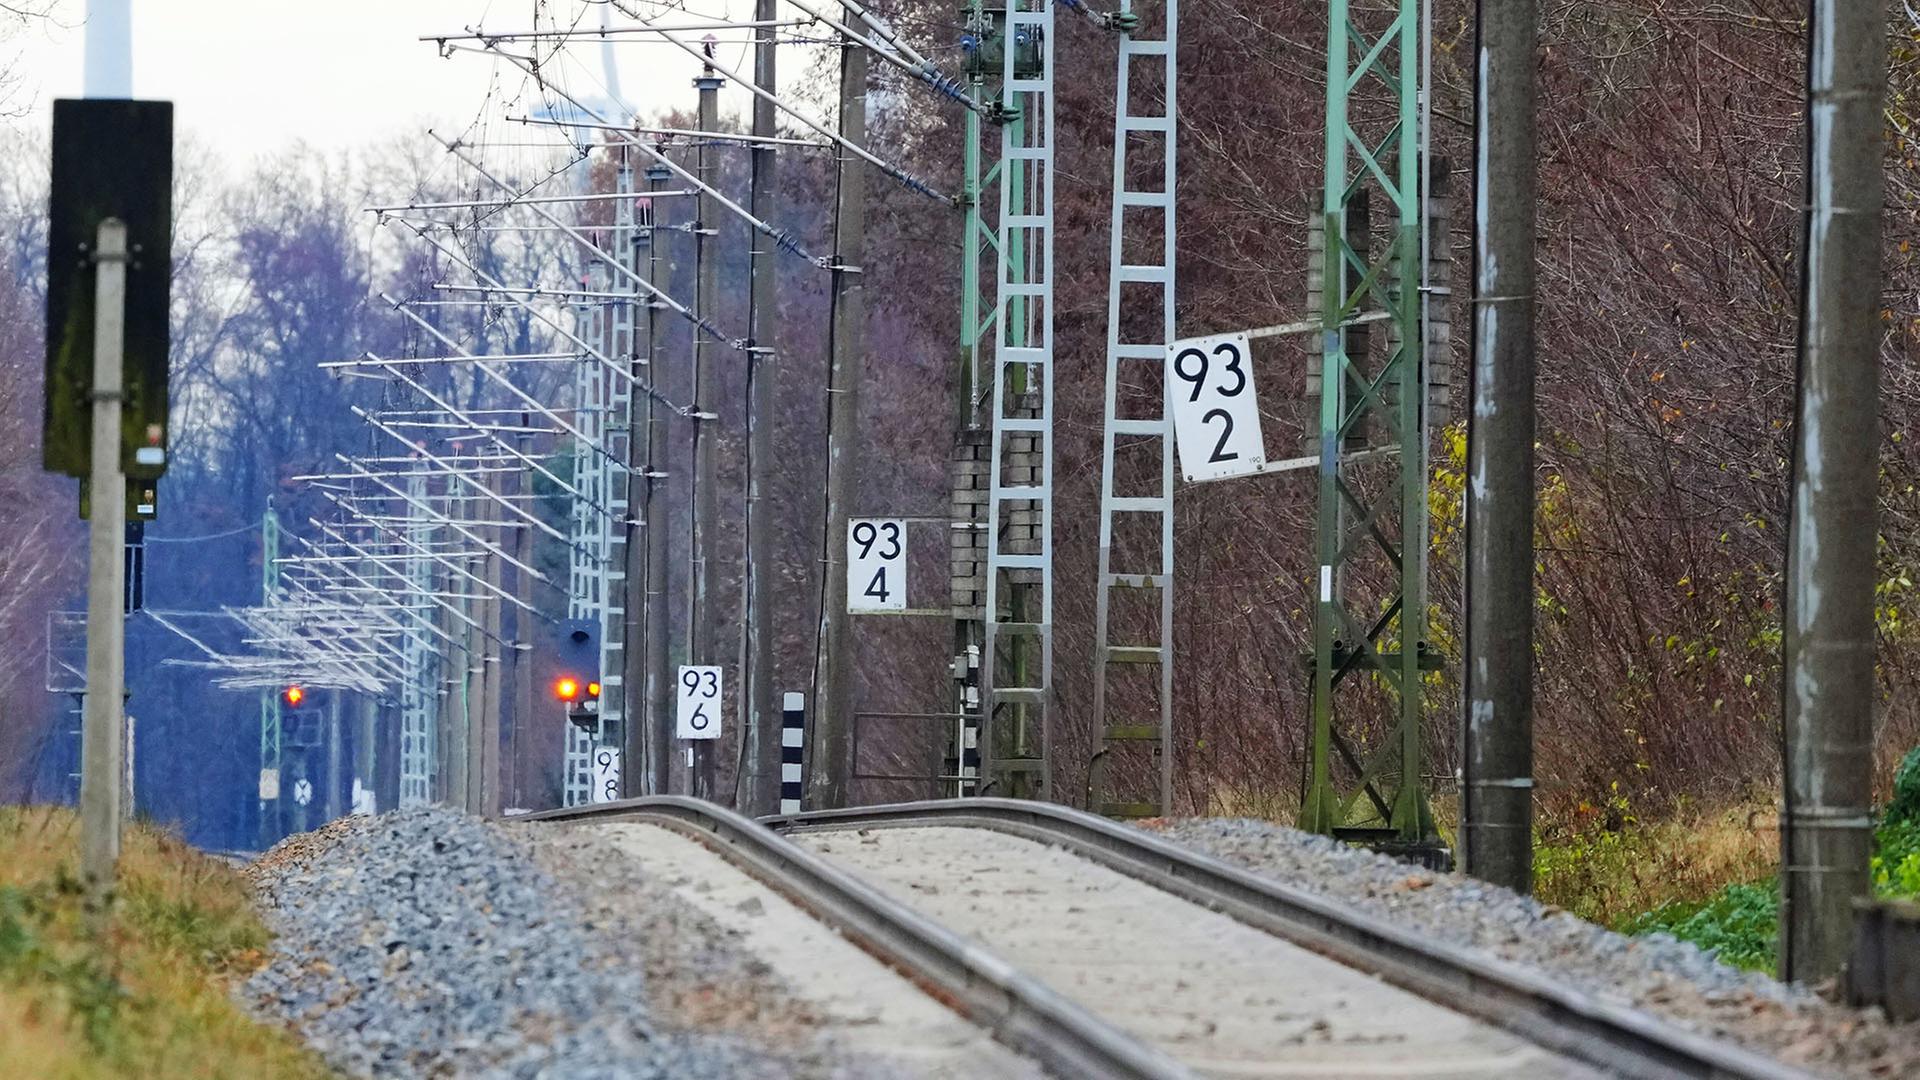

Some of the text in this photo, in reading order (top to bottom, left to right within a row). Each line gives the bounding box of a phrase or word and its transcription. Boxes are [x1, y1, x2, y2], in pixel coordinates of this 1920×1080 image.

[1174, 343, 1246, 403] 93
[1201, 408, 1239, 464] 2
[852, 522, 901, 560] 93
[863, 566, 890, 603] 4
[683, 670, 718, 698] 93
[690, 702, 709, 731] 6
[605, 779, 620, 801] 8
